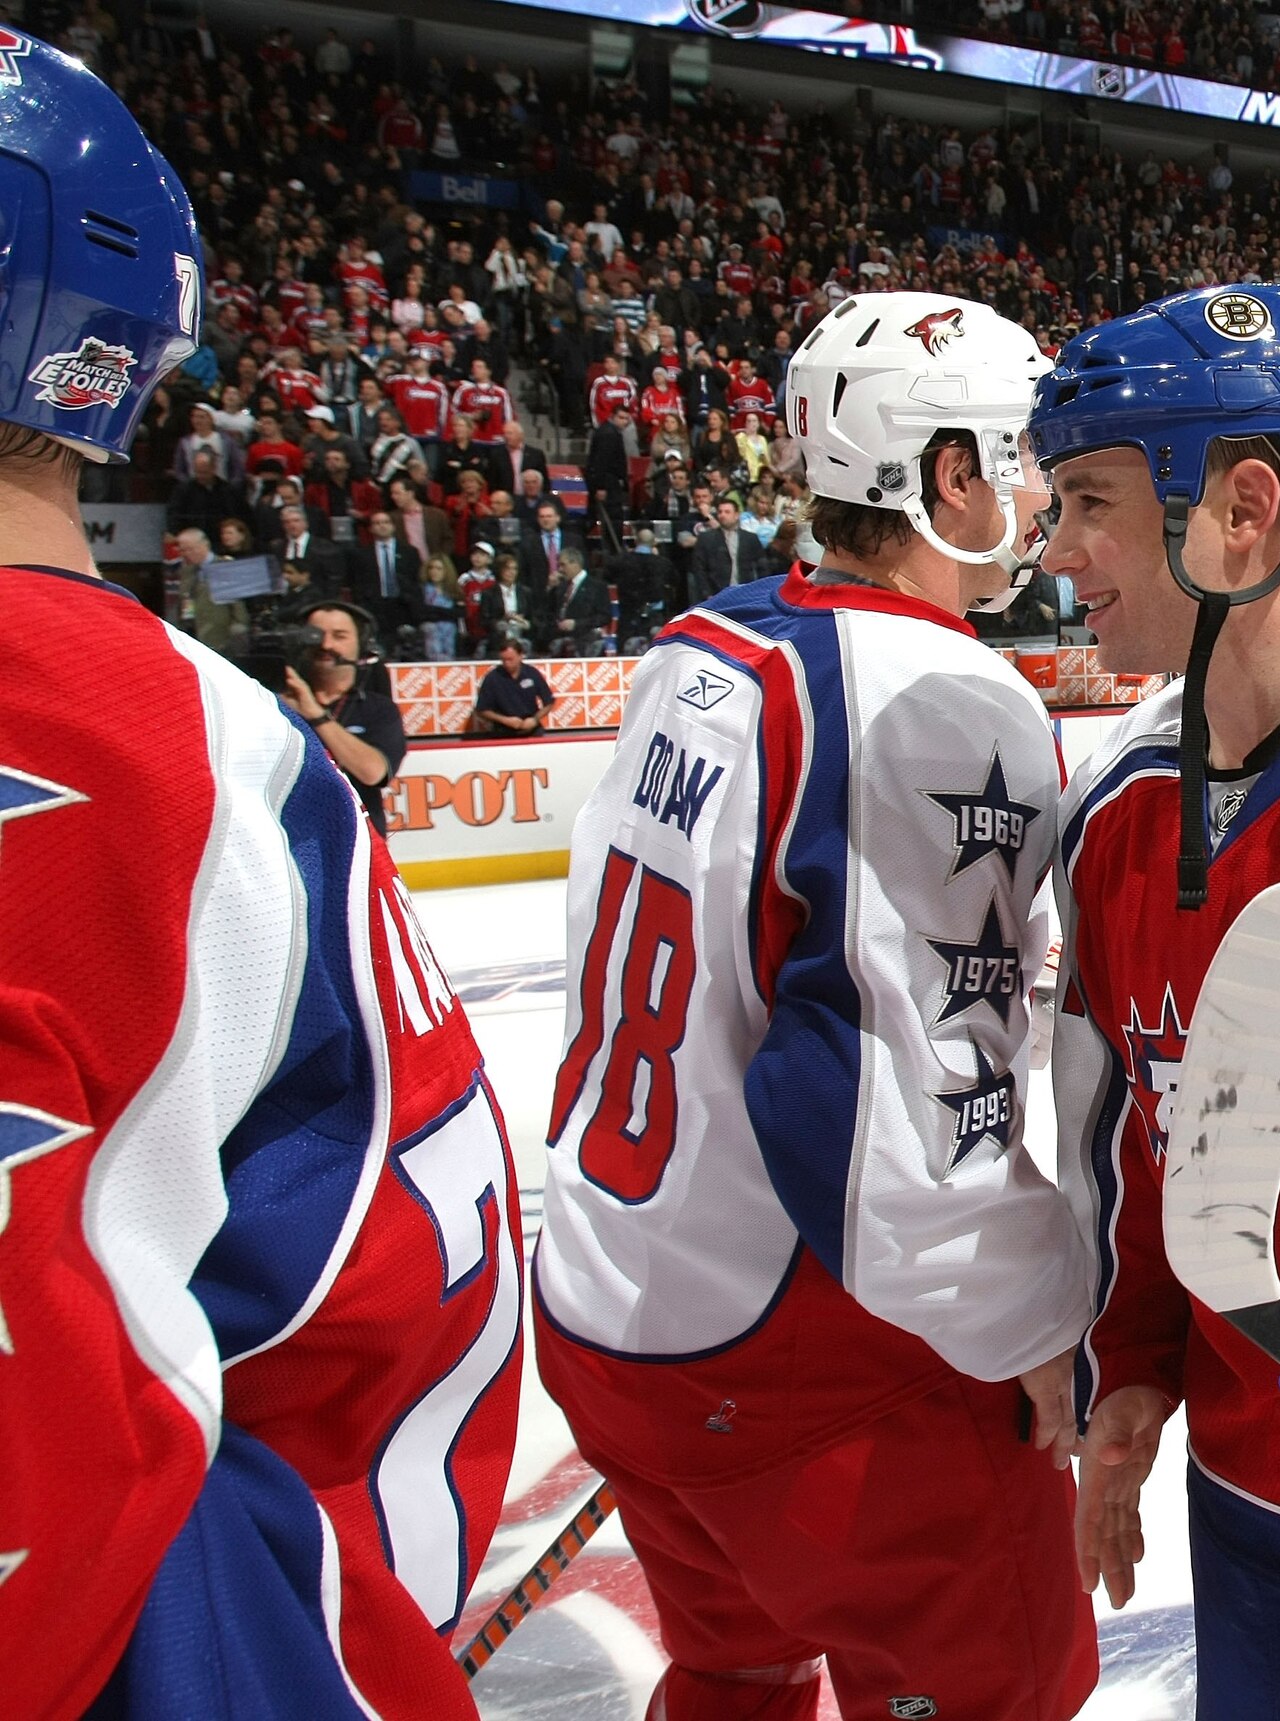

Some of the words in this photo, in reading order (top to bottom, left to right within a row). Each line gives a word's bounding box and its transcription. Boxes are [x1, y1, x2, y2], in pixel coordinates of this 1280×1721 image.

[442, 175, 487, 203] Bell
[947, 230, 981, 252] Bell
[1225, 302, 1253, 326] B
[65, 359, 111, 379] MATCH
[884, 469, 901, 486] NHL
[1059, 649, 1079, 669] HOME
[1064, 653, 1085, 676] DEPOT
[1087, 675, 1106, 697] HOME
[1092, 681, 1112, 704] DEPOT
[633, 730, 725, 843] DOAN
[960, 805, 1025, 849] 1969
[952, 955, 1017, 994] 1975
[545, 843, 697, 1206] 18
[961, 1087, 1012, 1136] 1993
